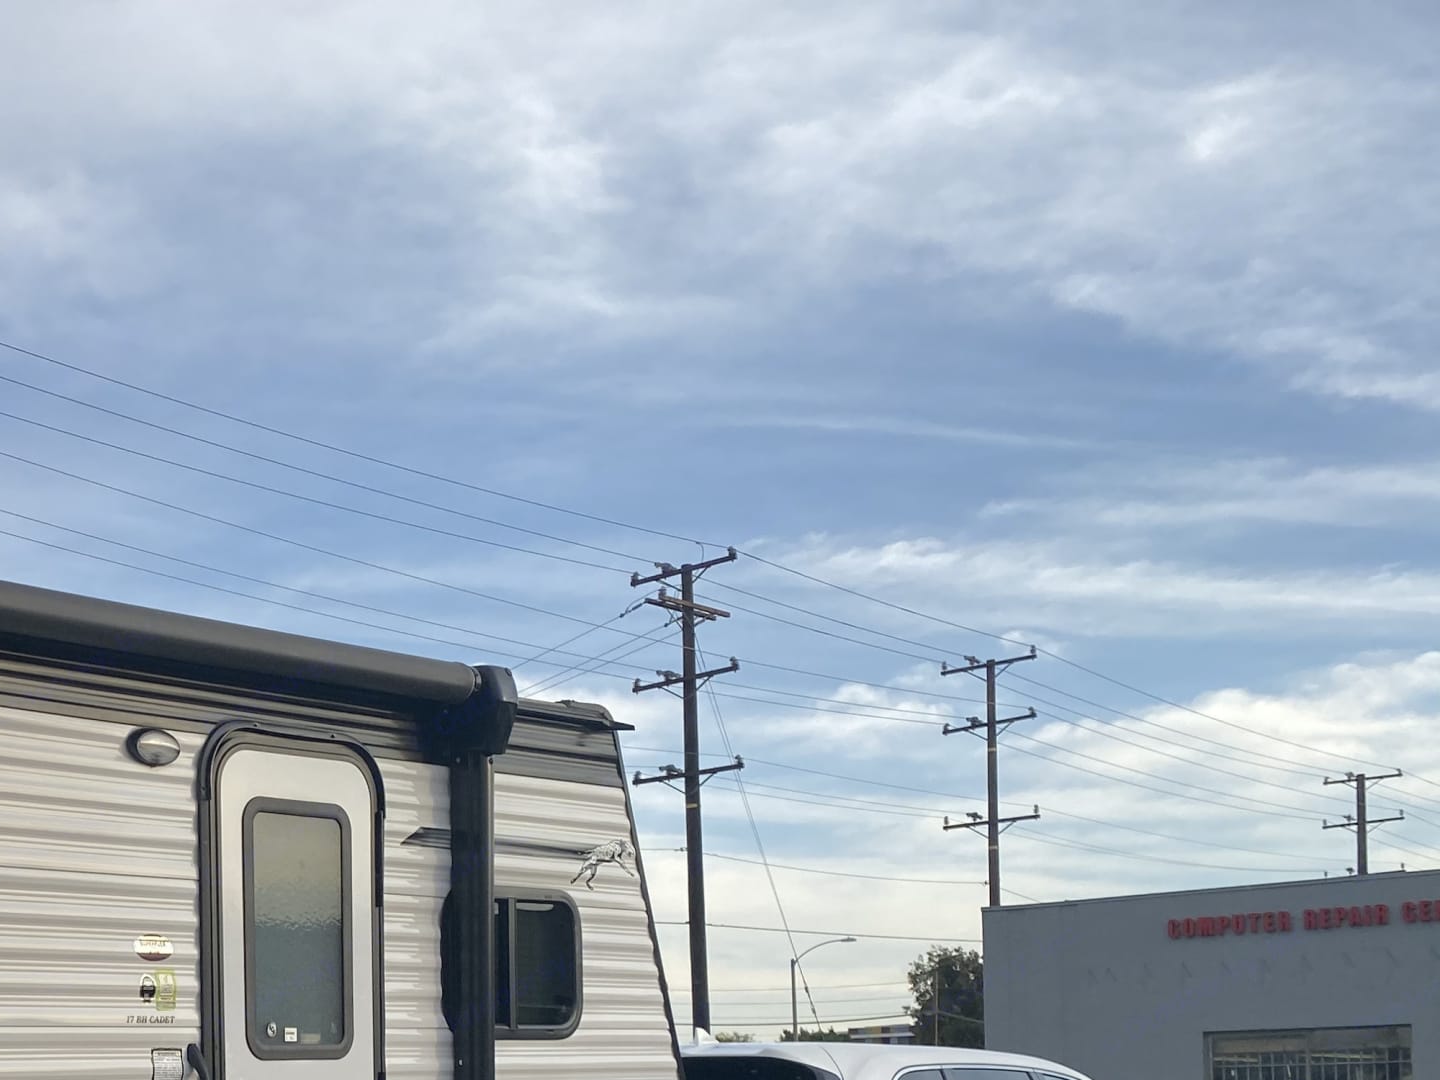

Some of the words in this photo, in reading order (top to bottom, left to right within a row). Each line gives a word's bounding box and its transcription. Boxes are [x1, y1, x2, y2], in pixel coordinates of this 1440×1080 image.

[1168, 911, 1292, 939] COMPUTER
[1304, 904, 1389, 930] REPAIR
[126, 1015, 135, 1024] 17
[149, 1015, 176, 1024] CADET
